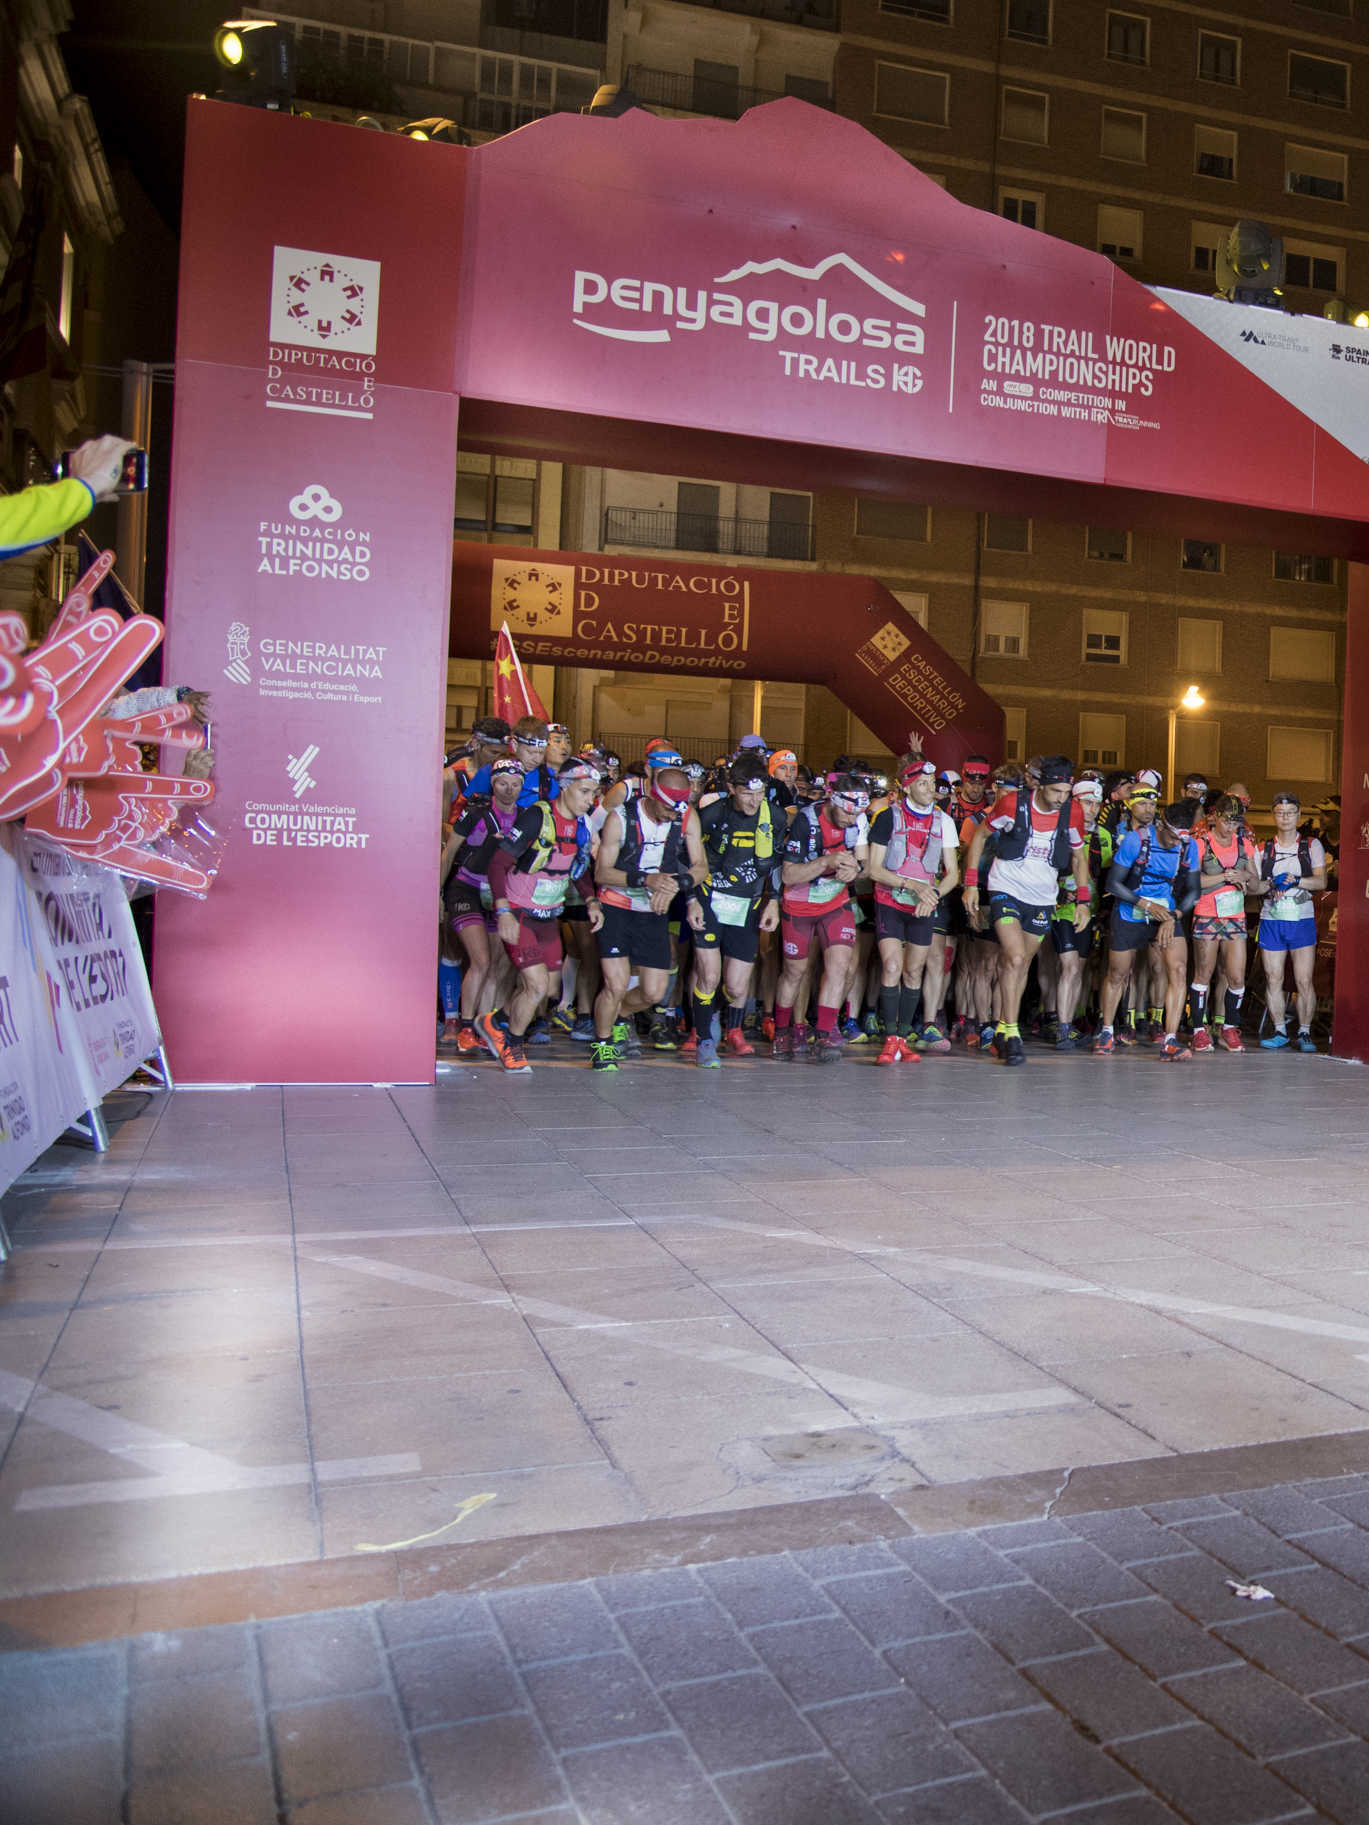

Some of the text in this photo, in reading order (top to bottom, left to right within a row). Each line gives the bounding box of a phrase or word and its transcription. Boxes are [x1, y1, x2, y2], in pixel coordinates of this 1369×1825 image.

[572, 269, 925, 354] penyagolosa
[983, 315, 1176, 372] 2018 TRAIL WORLD
[268, 347, 376, 373] DIPUTACIÓ
[778, 350, 886, 389] TRAILS
[983, 344, 1154, 396] CHAMPIONSHIPS
[266, 383, 375, 409] CASTELLÓ
[980, 378, 997, 392] AN
[1039, 387, 1112, 409] COMPETITION
[1115, 399, 1126, 411] IN
[980, 393, 1058, 416] CONJUNCTION
[1061, 405, 1089, 421] WITH
[259, 521, 371, 543] FUNDACIÓN
[257, 537, 371, 563] TRINIDAD
[257, 557, 371, 582] ALFONSO
[579, 566, 740, 596] DIPUTACIÓ
[576, 619, 738, 652] CASTELLÓ
[259, 638, 387, 662] GENERALITAT
[260, 656, 384, 680] VALENCIANA
[900, 663, 958, 720] ESCENARIO
[911, 653, 968, 713] CASTELLÓN,
[888, 673, 947, 730] DEPORTIVO
[245, 800, 356, 815] Comunitat Valenciana
[244, 812, 357, 832] COMUNITAT
[252, 830, 370, 849] DE L'ESPORT
